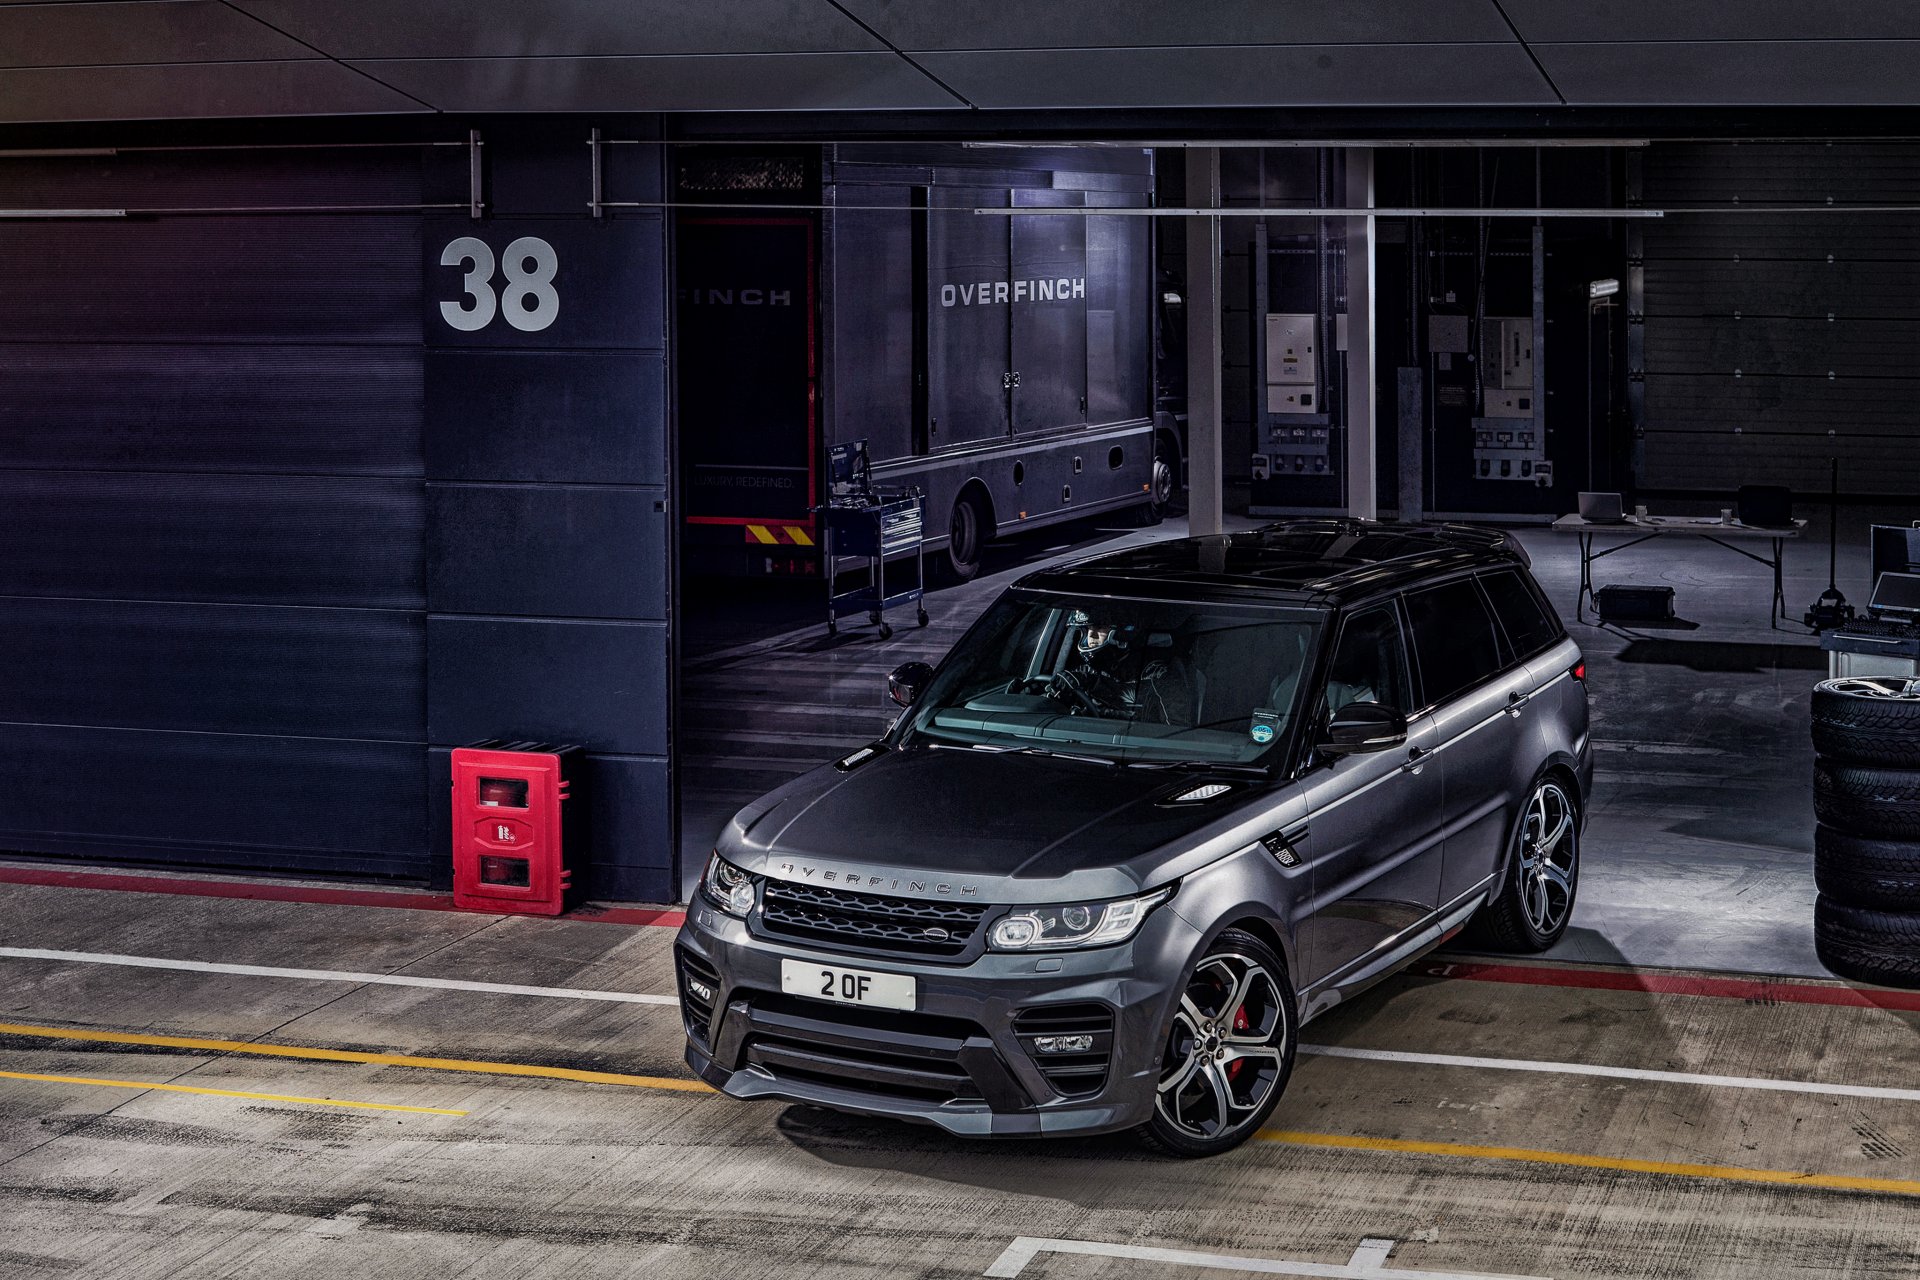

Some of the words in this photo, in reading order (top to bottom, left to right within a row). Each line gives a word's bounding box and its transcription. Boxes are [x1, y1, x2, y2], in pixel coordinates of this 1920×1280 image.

[440, 236, 560, 332] 38
[941, 278, 1085, 307] OVERFINCH
[781, 863, 977, 896] OVERFINCH
[820, 971, 835, 997] 2
[841, 973, 871, 1001] OF
